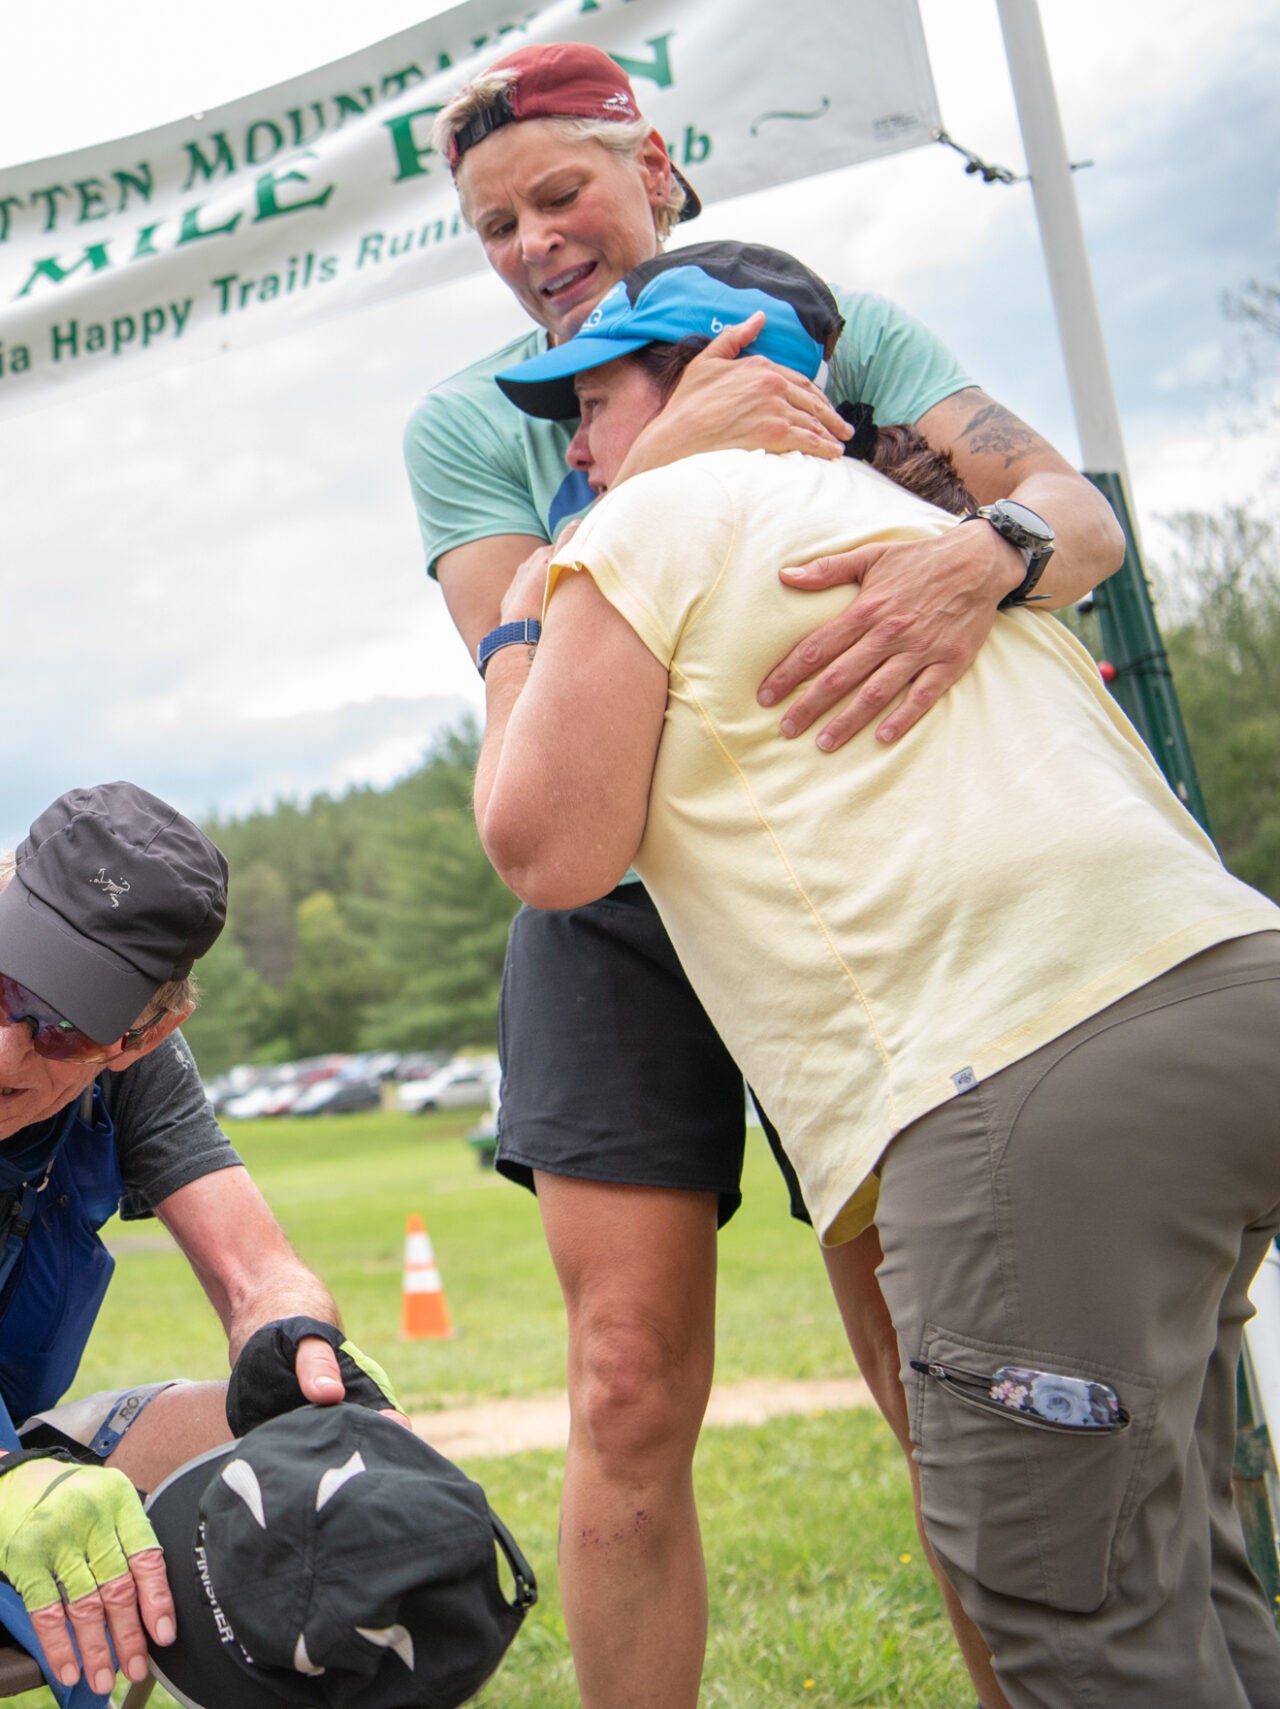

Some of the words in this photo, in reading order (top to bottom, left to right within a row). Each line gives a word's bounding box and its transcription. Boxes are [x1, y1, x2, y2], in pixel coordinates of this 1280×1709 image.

[17, 152, 335, 297] MILE
[52, 298, 193, 362] Happy
[212, 252, 338, 314] Trails
